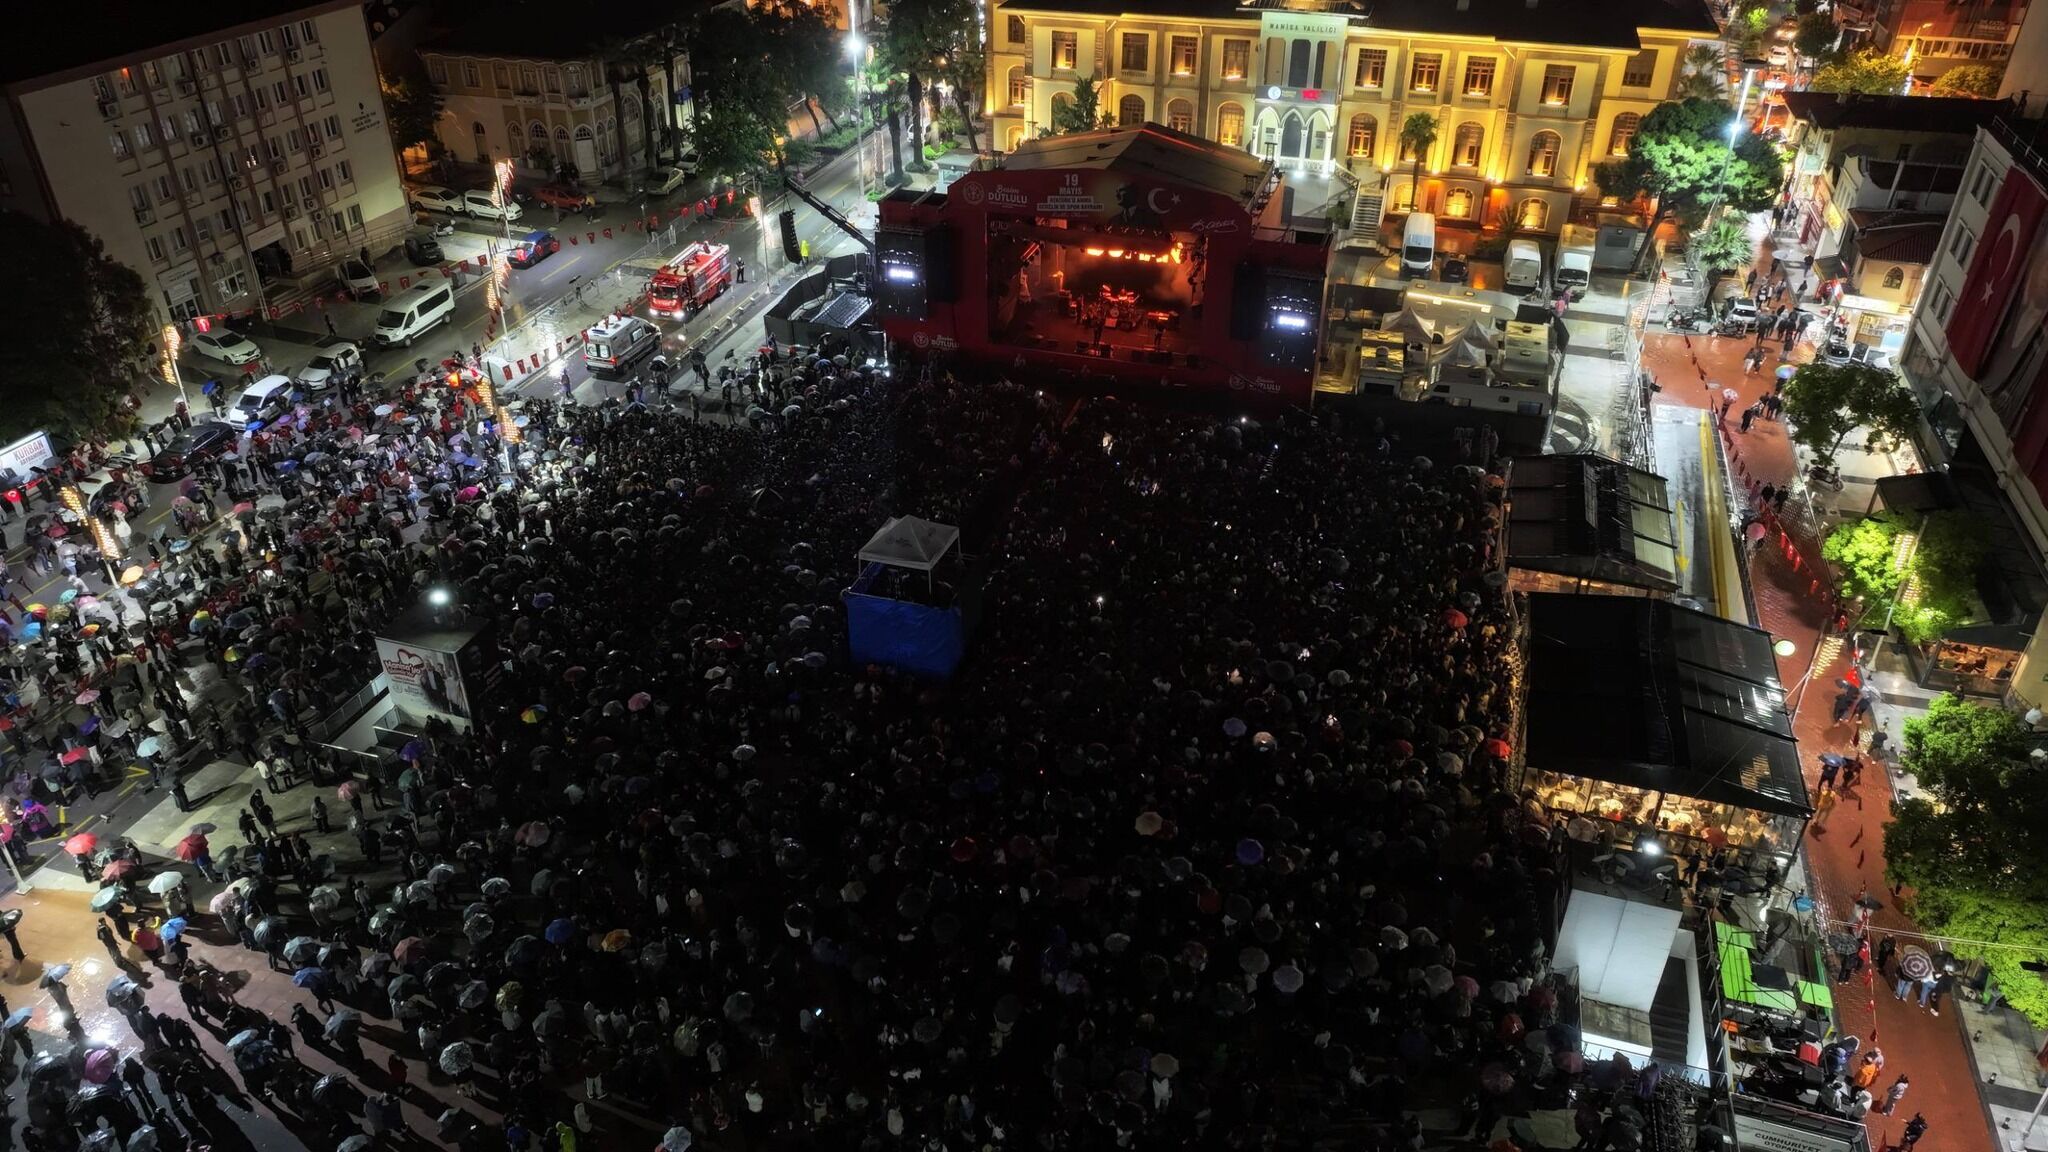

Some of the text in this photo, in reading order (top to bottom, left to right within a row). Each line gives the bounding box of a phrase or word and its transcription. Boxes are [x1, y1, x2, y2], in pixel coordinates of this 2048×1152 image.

[1064, 173, 1079, 186] 19
[987, 192, 1028, 204] DUTLULU
[12, 439, 44, 462] KURBAN
[1754, 1132, 1822, 1152] CUMHURİYET
